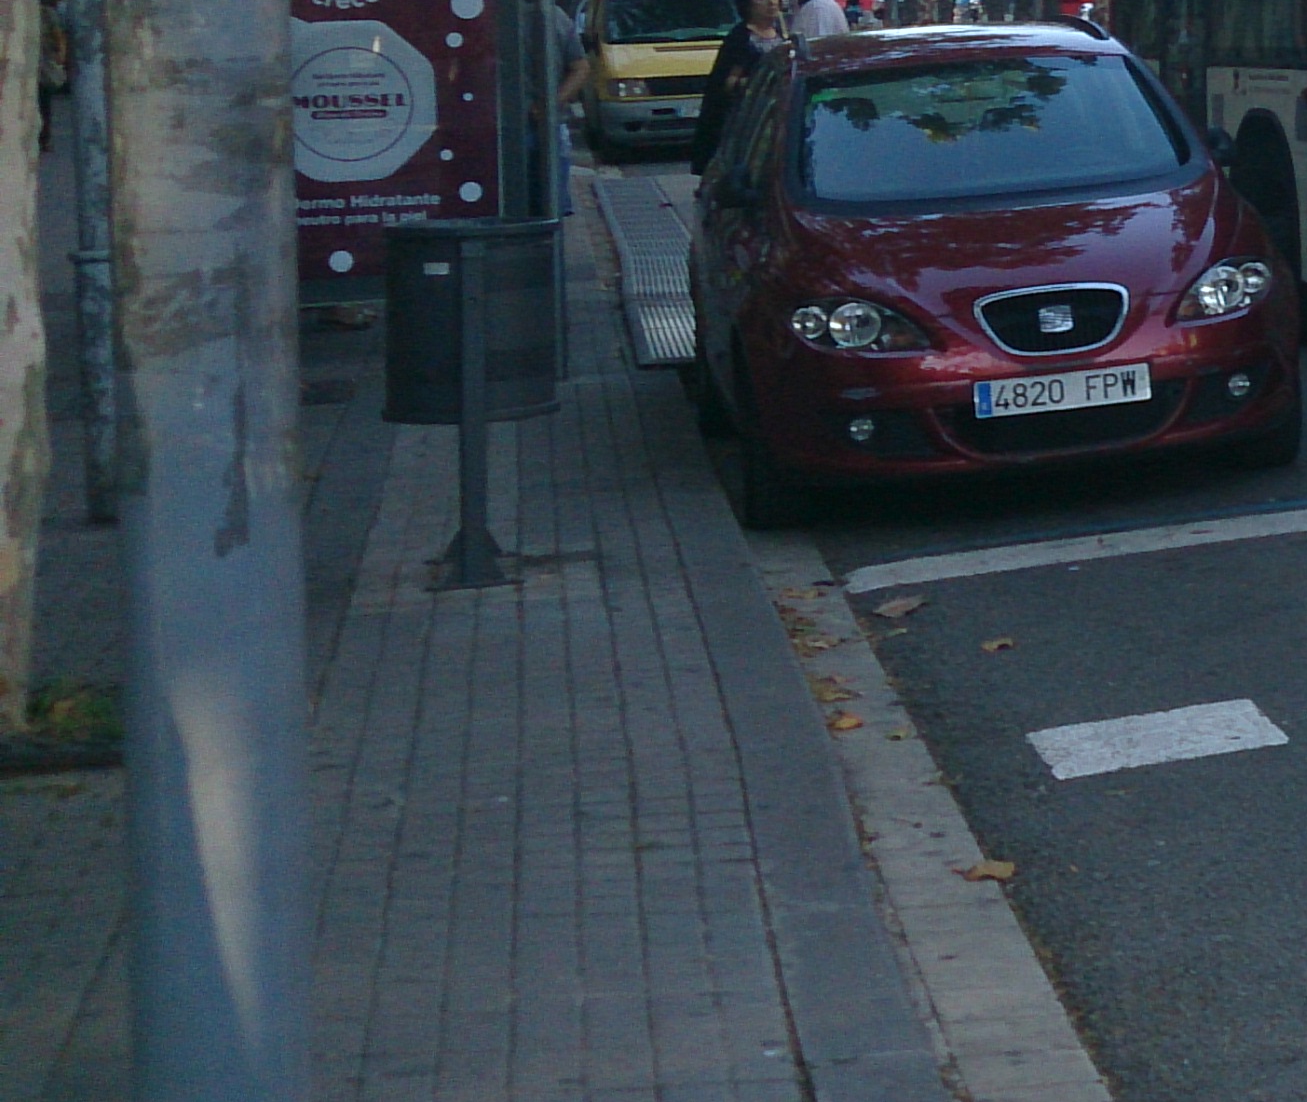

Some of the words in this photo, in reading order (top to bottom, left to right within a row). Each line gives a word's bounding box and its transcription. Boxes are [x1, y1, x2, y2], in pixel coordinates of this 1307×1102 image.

[350, 193, 441, 208] Hidratante
[994, 378, 1066, 411] 4820
[1085, 370, 1137, 402] FPW
